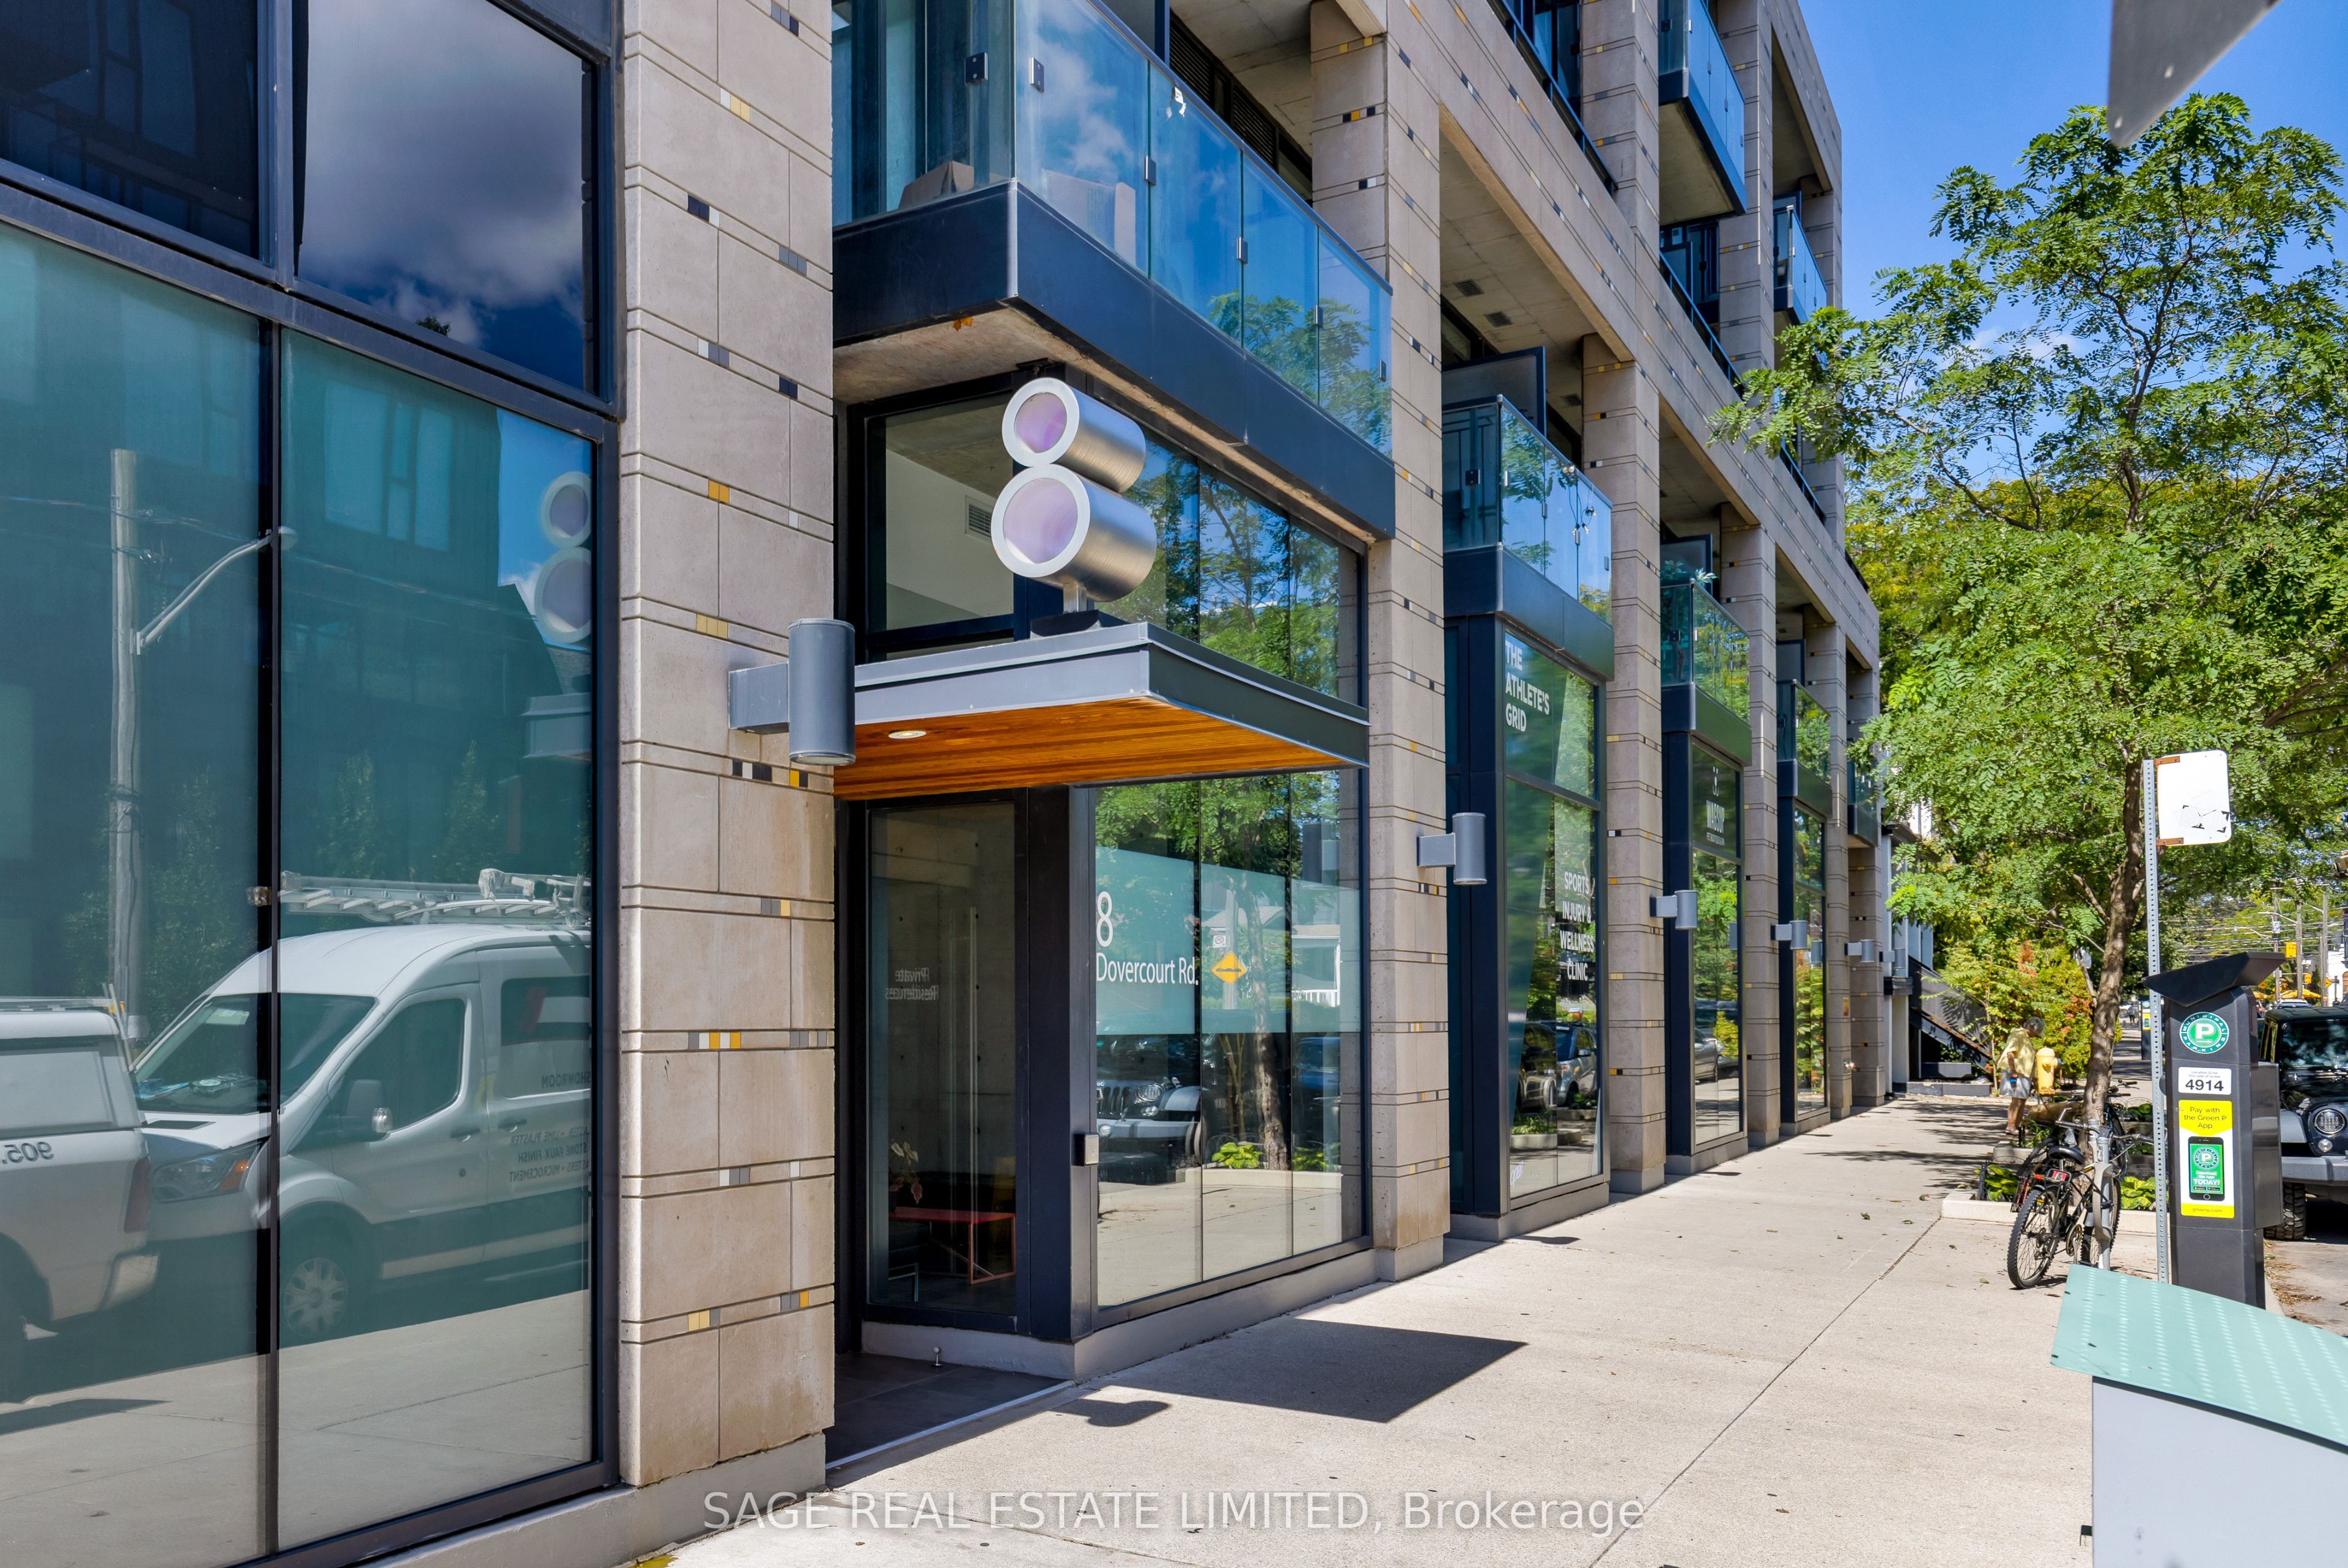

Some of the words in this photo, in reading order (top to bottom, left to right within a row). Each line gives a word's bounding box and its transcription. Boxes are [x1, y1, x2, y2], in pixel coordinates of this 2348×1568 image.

[1505, 641, 1523, 671] THE
[1505, 672, 1549, 715] ATHLETE'S
[1505, 703, 1527, 732] GRID
[1564, 871, 1590, 894] SPORTS
[1096, 891, 1113, 948] 8
[1562, 900, 1586, 922] INJURY
[1587, 906, 1592, 924] &
[1560, 930, 1595, 952] WELLNESS
[1096, 952, 1175, 984] Dovercourt
[1179, 957, 1198, 985] Rd.
[1567, 962, 1589, 981] CLINIC
[2182, 1014, 2226, 1032] MUNICIPAL
[2196, 1023, 2215, 1039] P
[2183, 1036, 2226, 1052] PARKING
[2185, 1080, 2224, 1091] 4914
